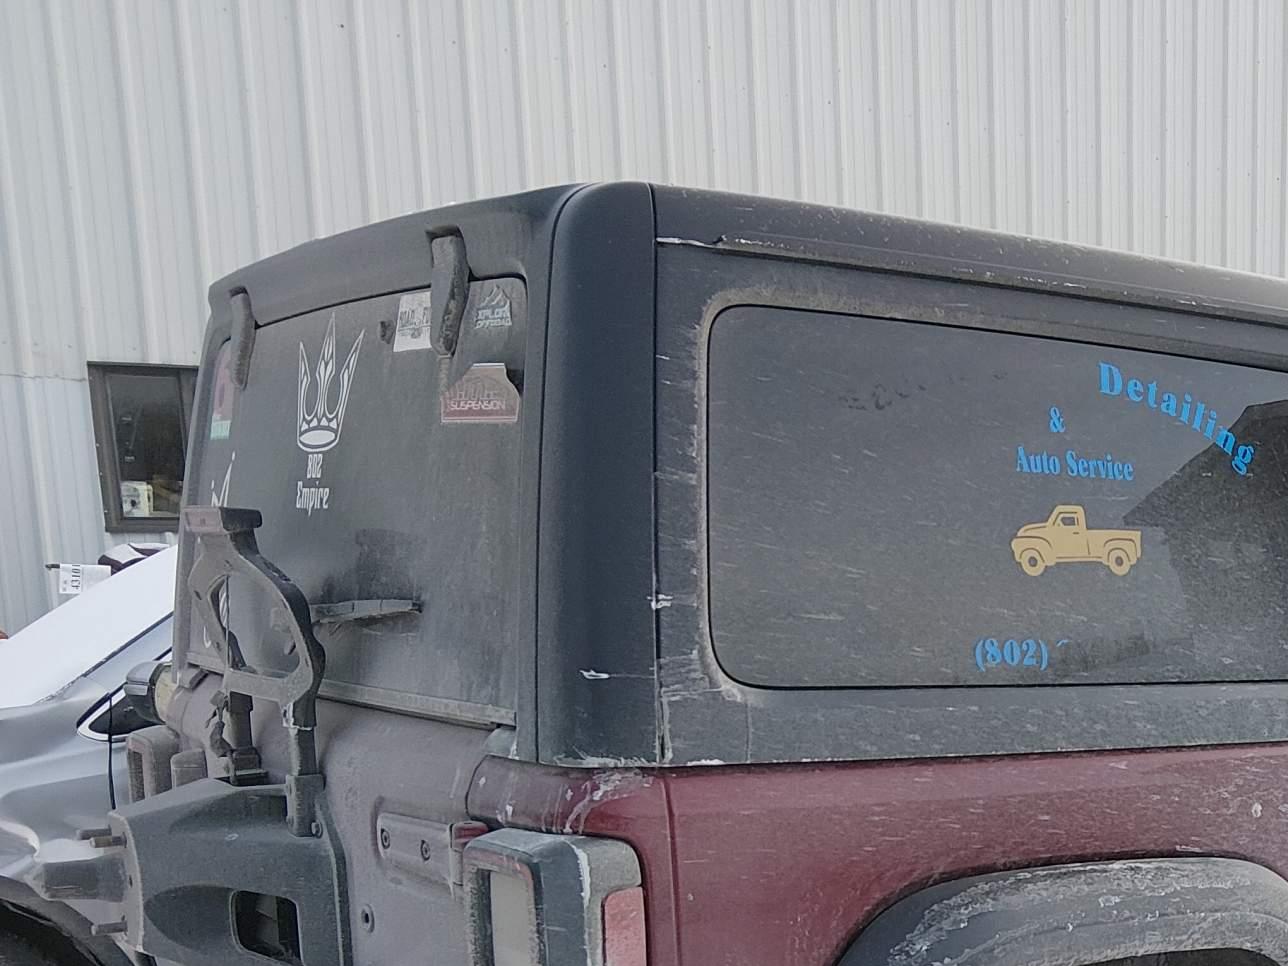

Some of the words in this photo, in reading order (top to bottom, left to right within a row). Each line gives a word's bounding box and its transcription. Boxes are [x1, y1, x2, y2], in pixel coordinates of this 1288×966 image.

[449, 399, 505, 411] SUSPENSION
[1049, 405, 1067, 433] &
[1097, 360, 1255, 476] Detailing
[306, 453, 323, 479] 802
[1015, 446, 1061, 474] Auto
[1066, 449, 1135, 481] Service
[296, 480, 330, 516] Empire
[975, 638, 1049, 672] (802)
